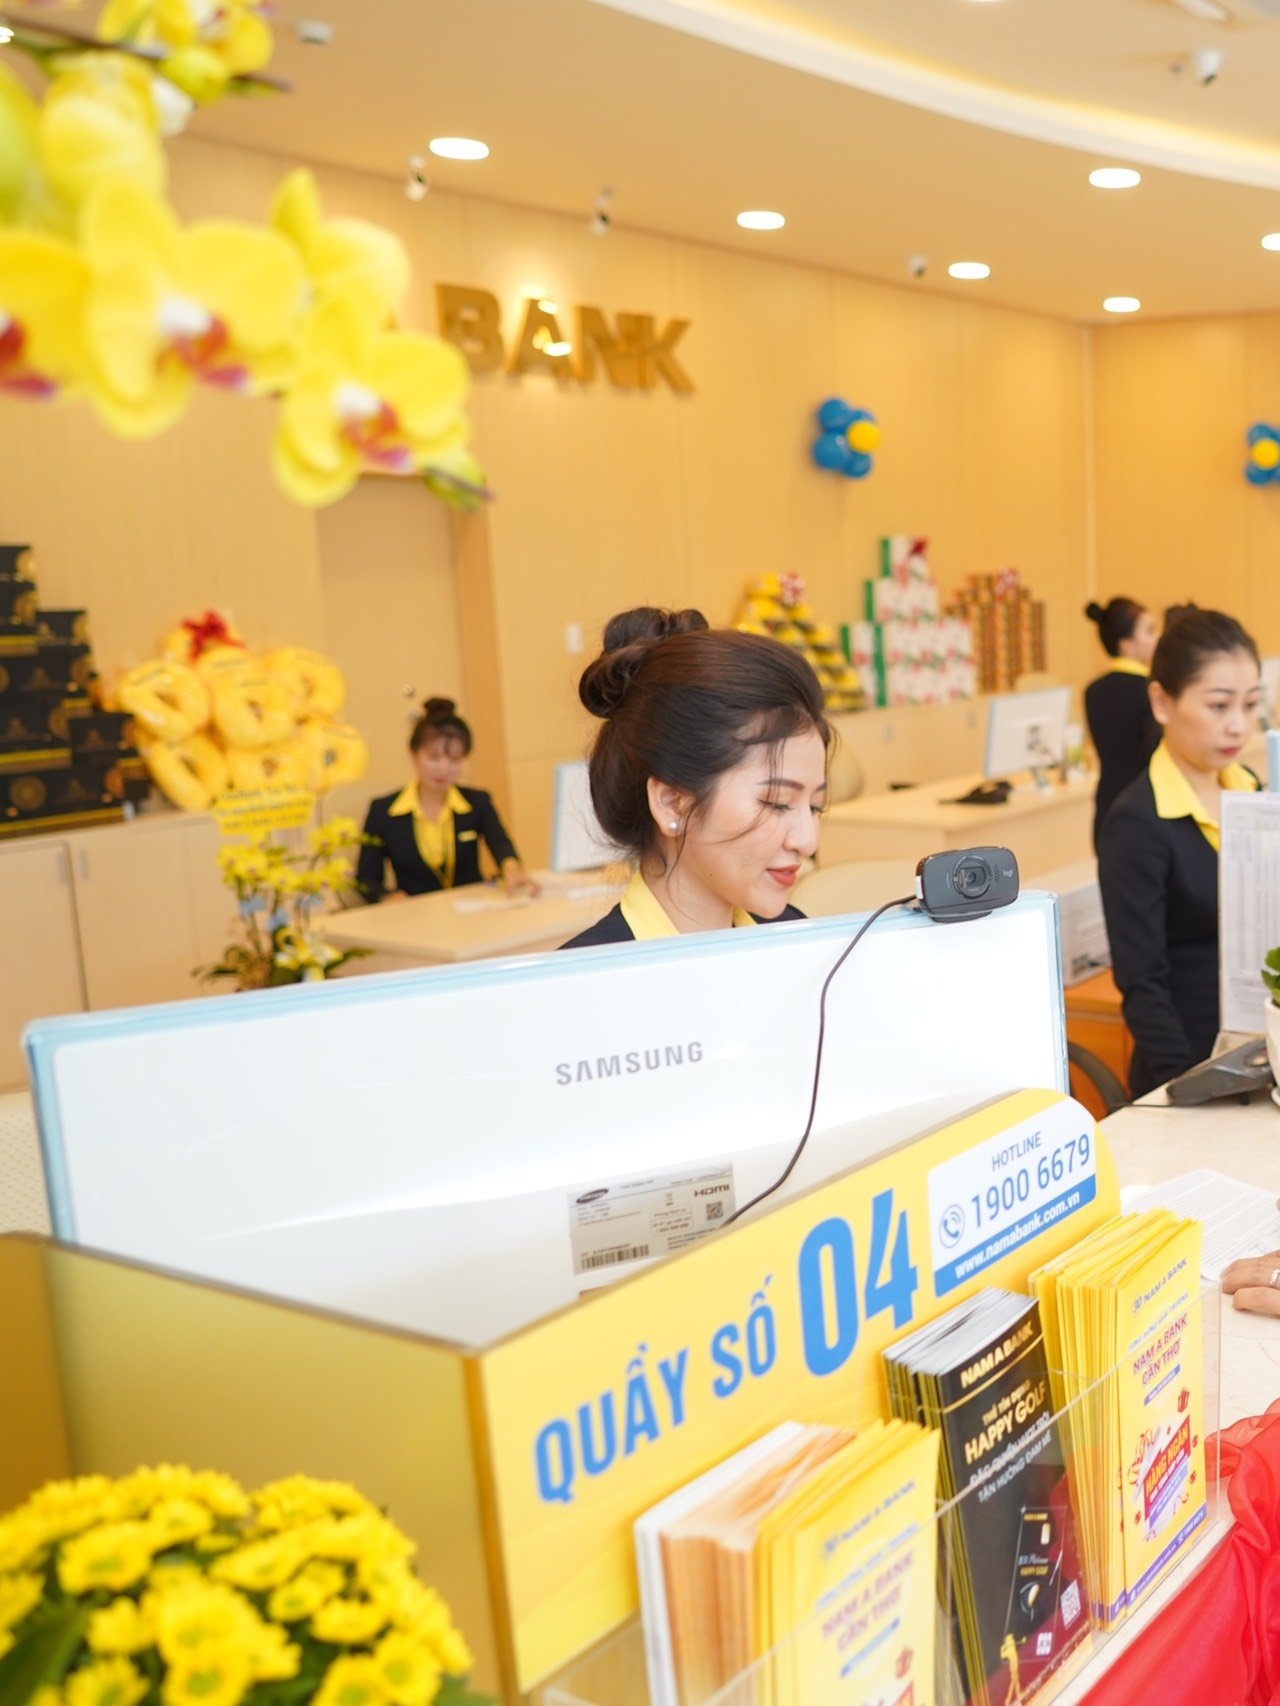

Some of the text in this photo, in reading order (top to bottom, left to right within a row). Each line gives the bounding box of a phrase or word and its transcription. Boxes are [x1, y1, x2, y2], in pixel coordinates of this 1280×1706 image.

[434, 283, 697, 397] BANK
[556, 1041, 703, 1086] SAMSUNG
[971, 1133, 1090, 1229] 1900 6679
[991, 1131, 1042, 1172] HOTLINE
[694, 1184, 730, 1198] HDMI
[954, 1191, 1081, 1279] www.namabank.com.vn
[1167, 1257, 1188, 1283] BANK
[534, 1187, 919, 1504] QUẦY SỐ 04
[960, 1321, 1033, 1388] NAM A BANK
[1133, 1348, 1155, 1376] NAM
[1163, 1312, 1188, 1345] BANK
[964, 1380, 1046, 1465] HAPPY GOLF
